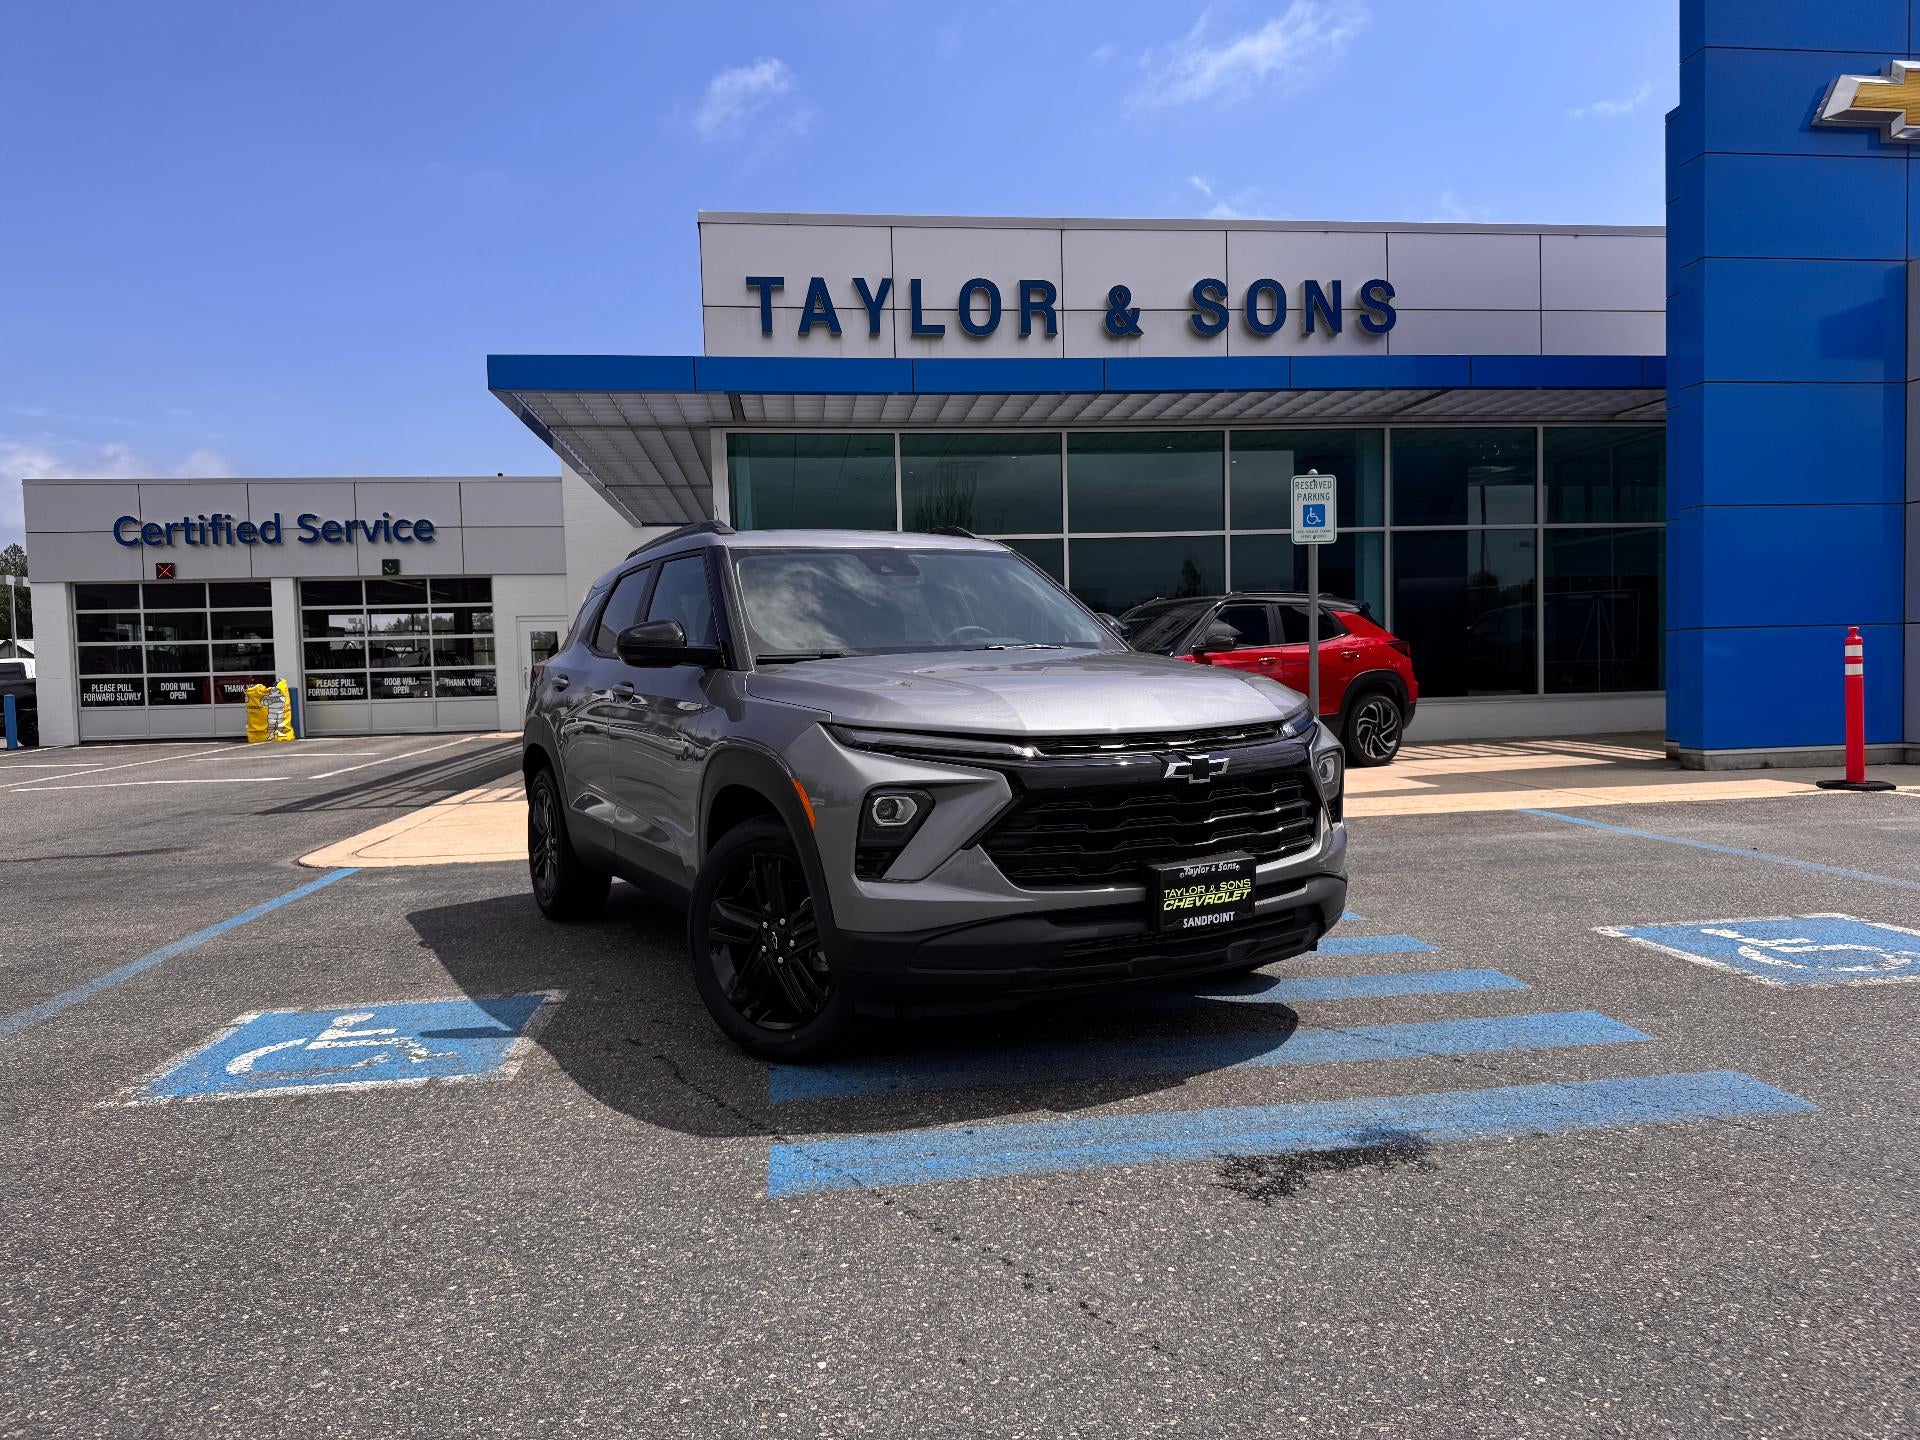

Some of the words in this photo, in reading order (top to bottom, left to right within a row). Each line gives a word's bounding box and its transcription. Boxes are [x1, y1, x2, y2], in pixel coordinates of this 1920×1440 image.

[745, 276, 1060, 338] TAYLOR
[1103, 285, 1145, 337] &
[1190, 278, 1398, 336] SONS
[1295, 481, 1332, 490] RESERVED
[1297, 493, 1330, 501] PARKING
[113, 512, 283, 547] Certified
[296, 511, 436, 544] Service
[316, 679, 339, 688] PLEASE
[340, 679, 356, 687] PULL
[384, 678, 401, 686] DOOR
[402, 677, 418, 685] WILL
[446, 678, 465, 687] THANK
[91, 684, 115, 692] PLEASE
[117, 683, 134, 692] PULL
[160, 683, 178, 691] DOOR
[179, 682, 196, 690] WILL
[224, 684, 244, 693] THANK
[393, 686, 410, 694] OPEN
[83, 692, 115, 701] FORWARD
[116, 692, 141, 700] SLOWLY
[169, 691, 187, 700] OPEN
[308, 687, 339, 697] FORWARD
[340, 687, 364, 696] SLOWLY
[1184, 865, 1210, 877] Taylor
[1218, 863, 1236, 872] Sons
[1164, 885, 1206, 899] TAYLOR
[1209, 884, 1216, 894] &
[1219, 879, 1251, 891] SONS
[1163, 888, 1252, 911] CHEVROLET
[1183, 911, 1235, 928] SANDPOINT
